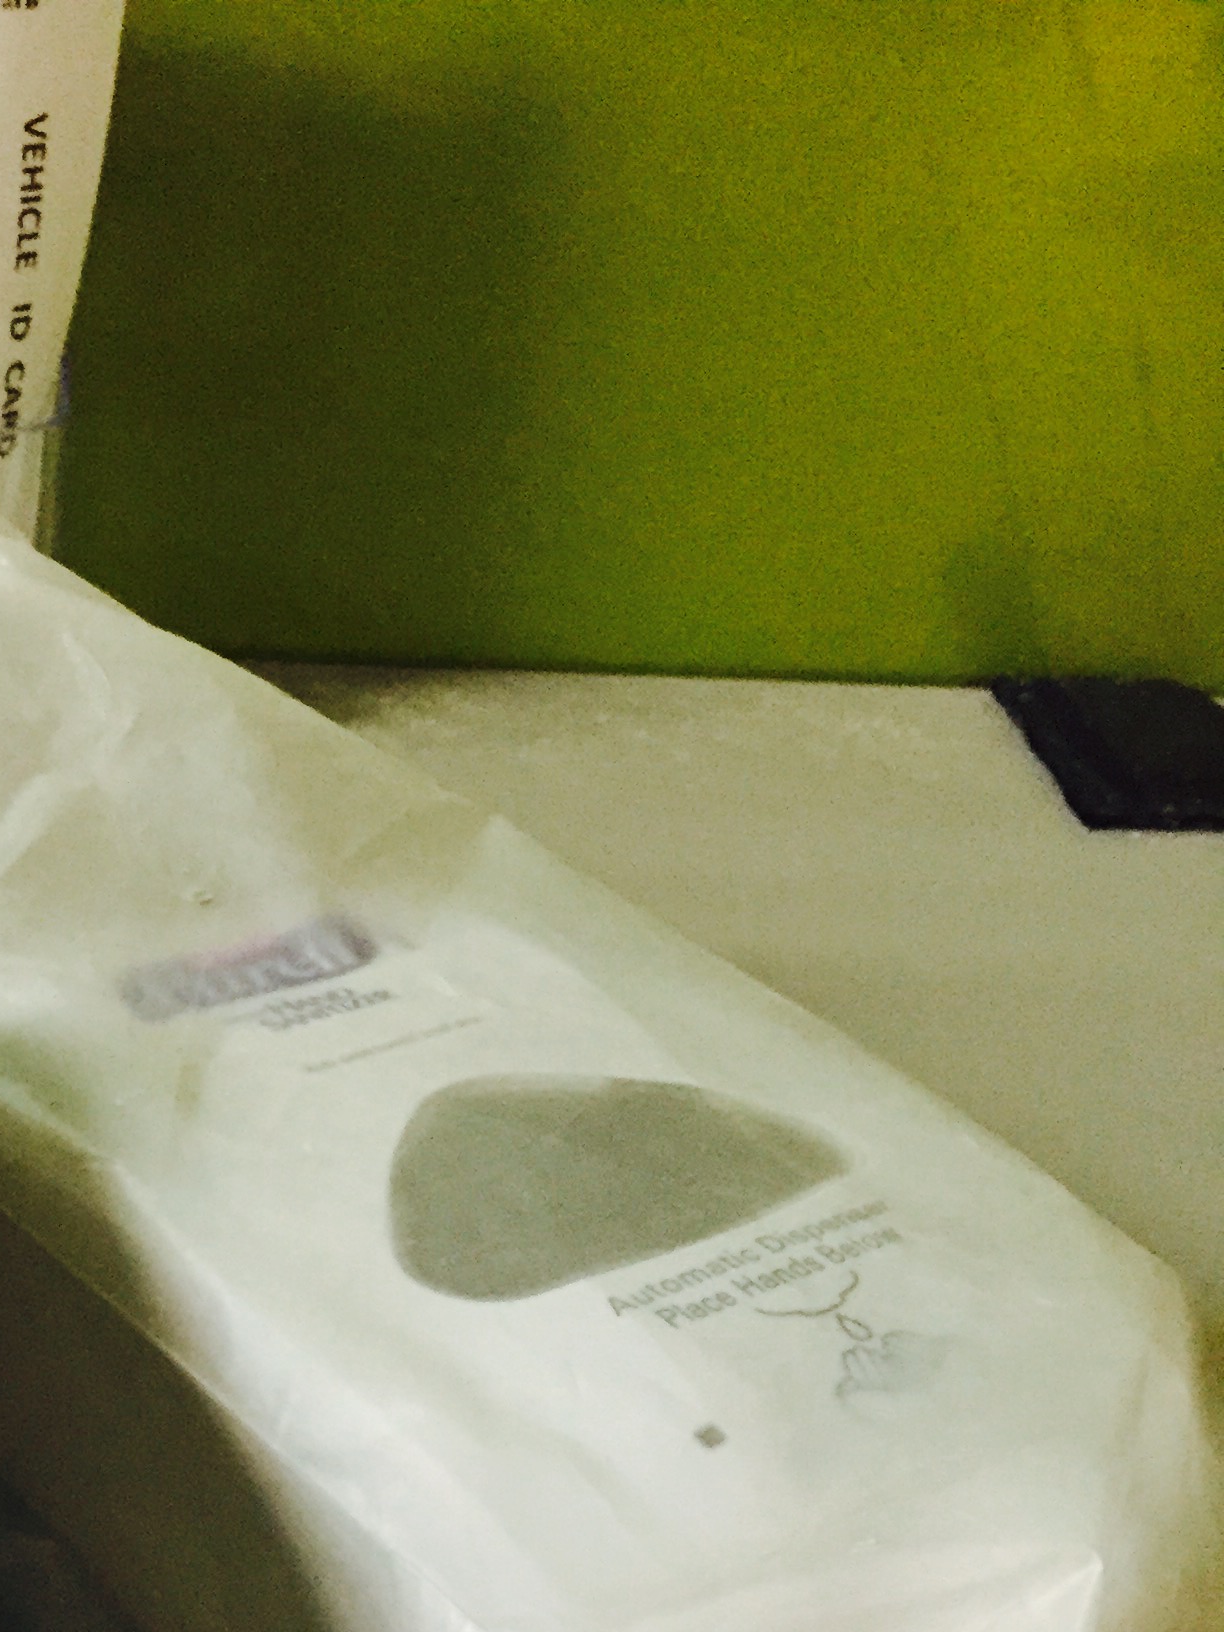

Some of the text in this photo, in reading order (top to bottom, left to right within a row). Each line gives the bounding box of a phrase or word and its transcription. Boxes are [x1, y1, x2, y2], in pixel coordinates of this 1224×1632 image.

[14, 112, 48, 271] VEHICLE
[10, 303, 33, 341] ID
[607, 1249, 760, 1316] Automatic
[654, 1291, 738, 1329] Place
[731, 1255, 825, 1298] Hands
